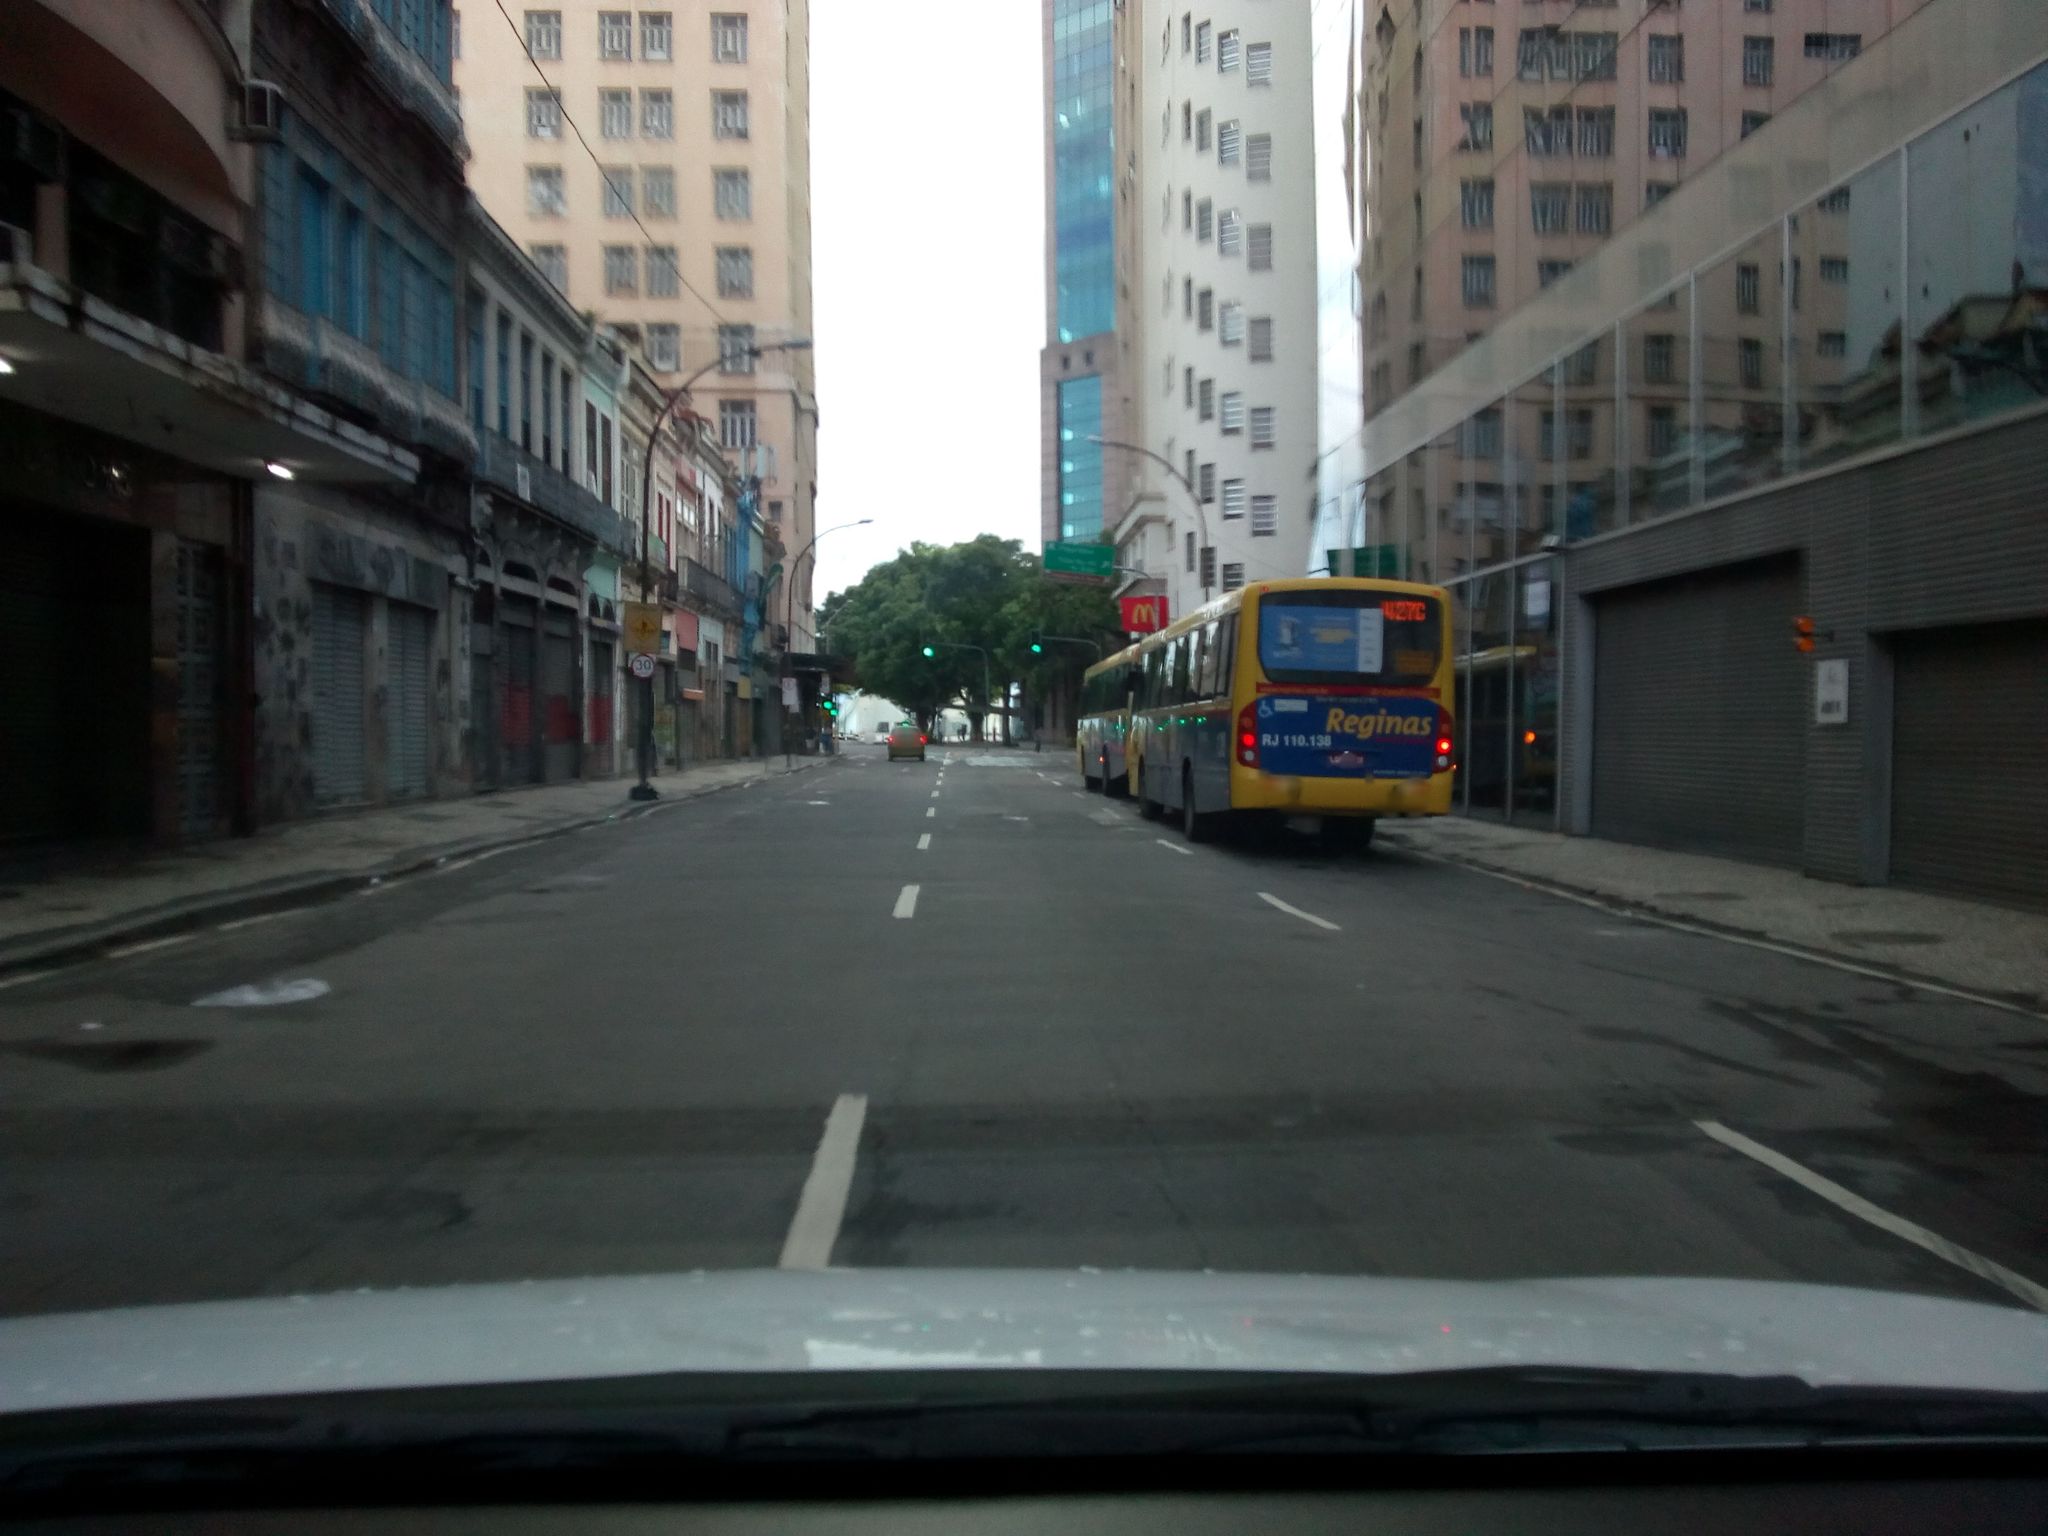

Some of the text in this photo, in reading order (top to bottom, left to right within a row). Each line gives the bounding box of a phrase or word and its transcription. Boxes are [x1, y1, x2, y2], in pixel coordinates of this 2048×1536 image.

[635, 660, 652, 671] 30
[1326, 707, 1432, 739] Reginas
[1262, 733, 1332, 747] RJ 110.138
